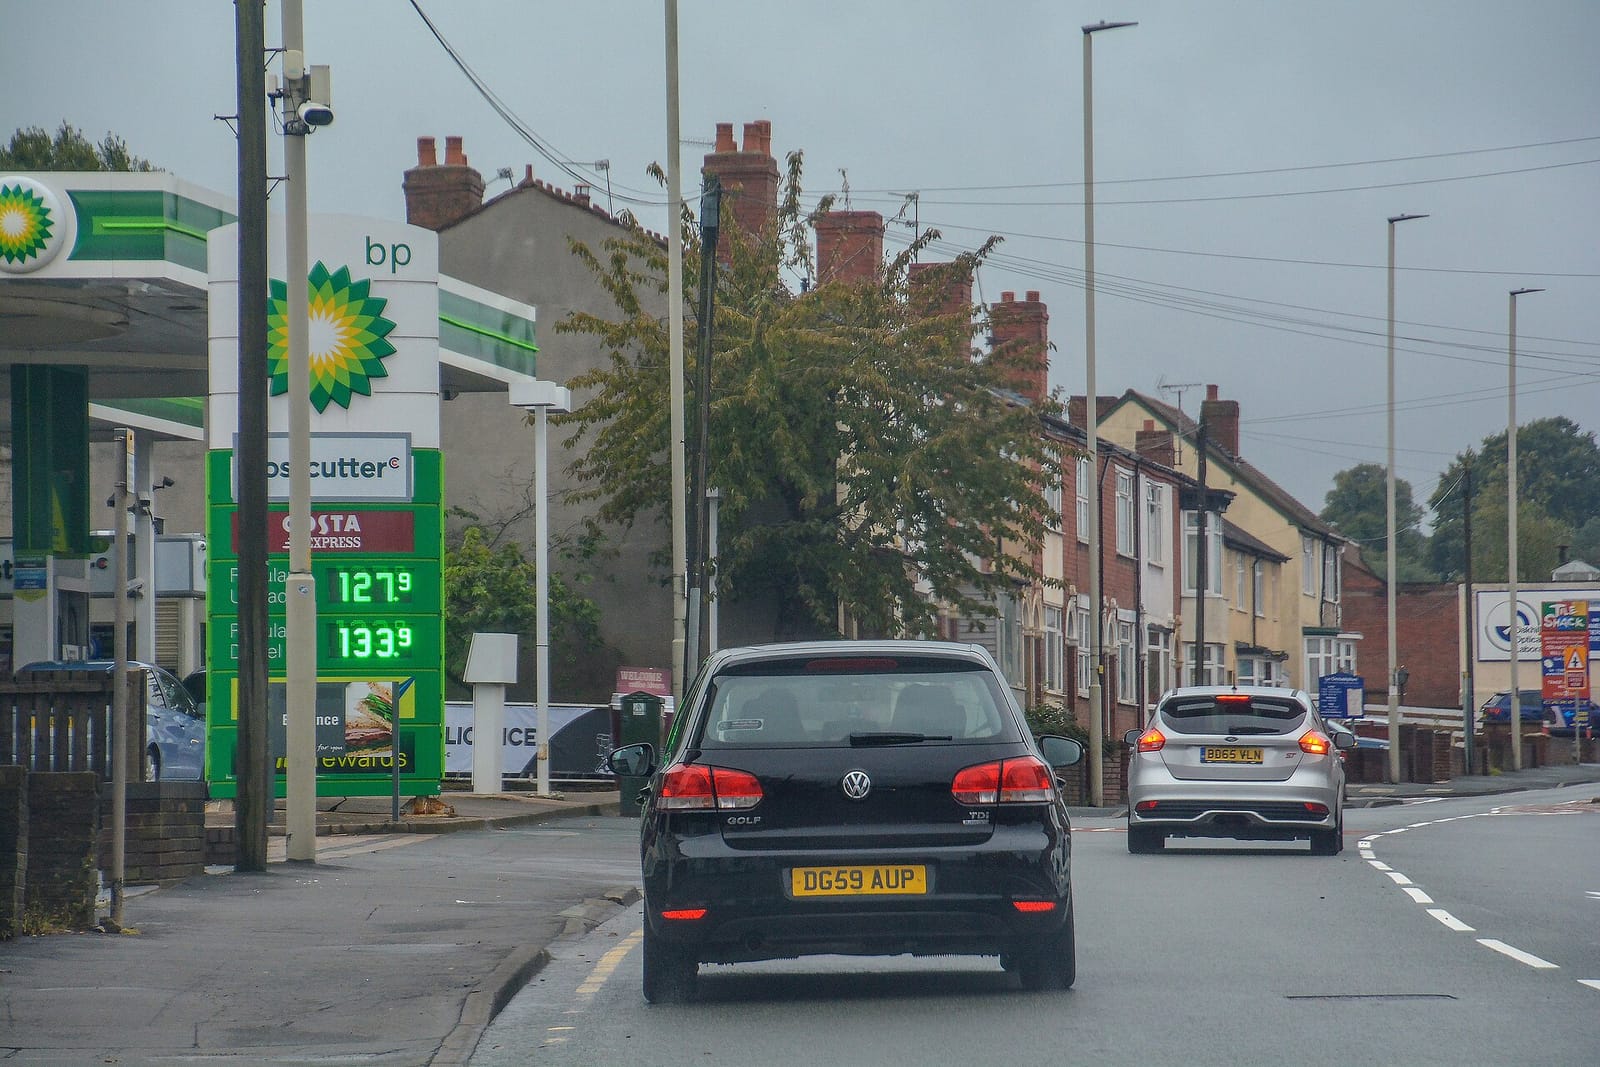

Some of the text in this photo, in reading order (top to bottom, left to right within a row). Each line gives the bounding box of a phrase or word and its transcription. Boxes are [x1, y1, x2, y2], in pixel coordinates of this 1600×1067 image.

[365, 235, 412, 274] bp
[338, 627, 412, 659] 133.9
[620, 670, 663, 682] WELCOME
[727, 816, 761, 825] GOLF
[803, 868, 916, 891] DG59 AUP
